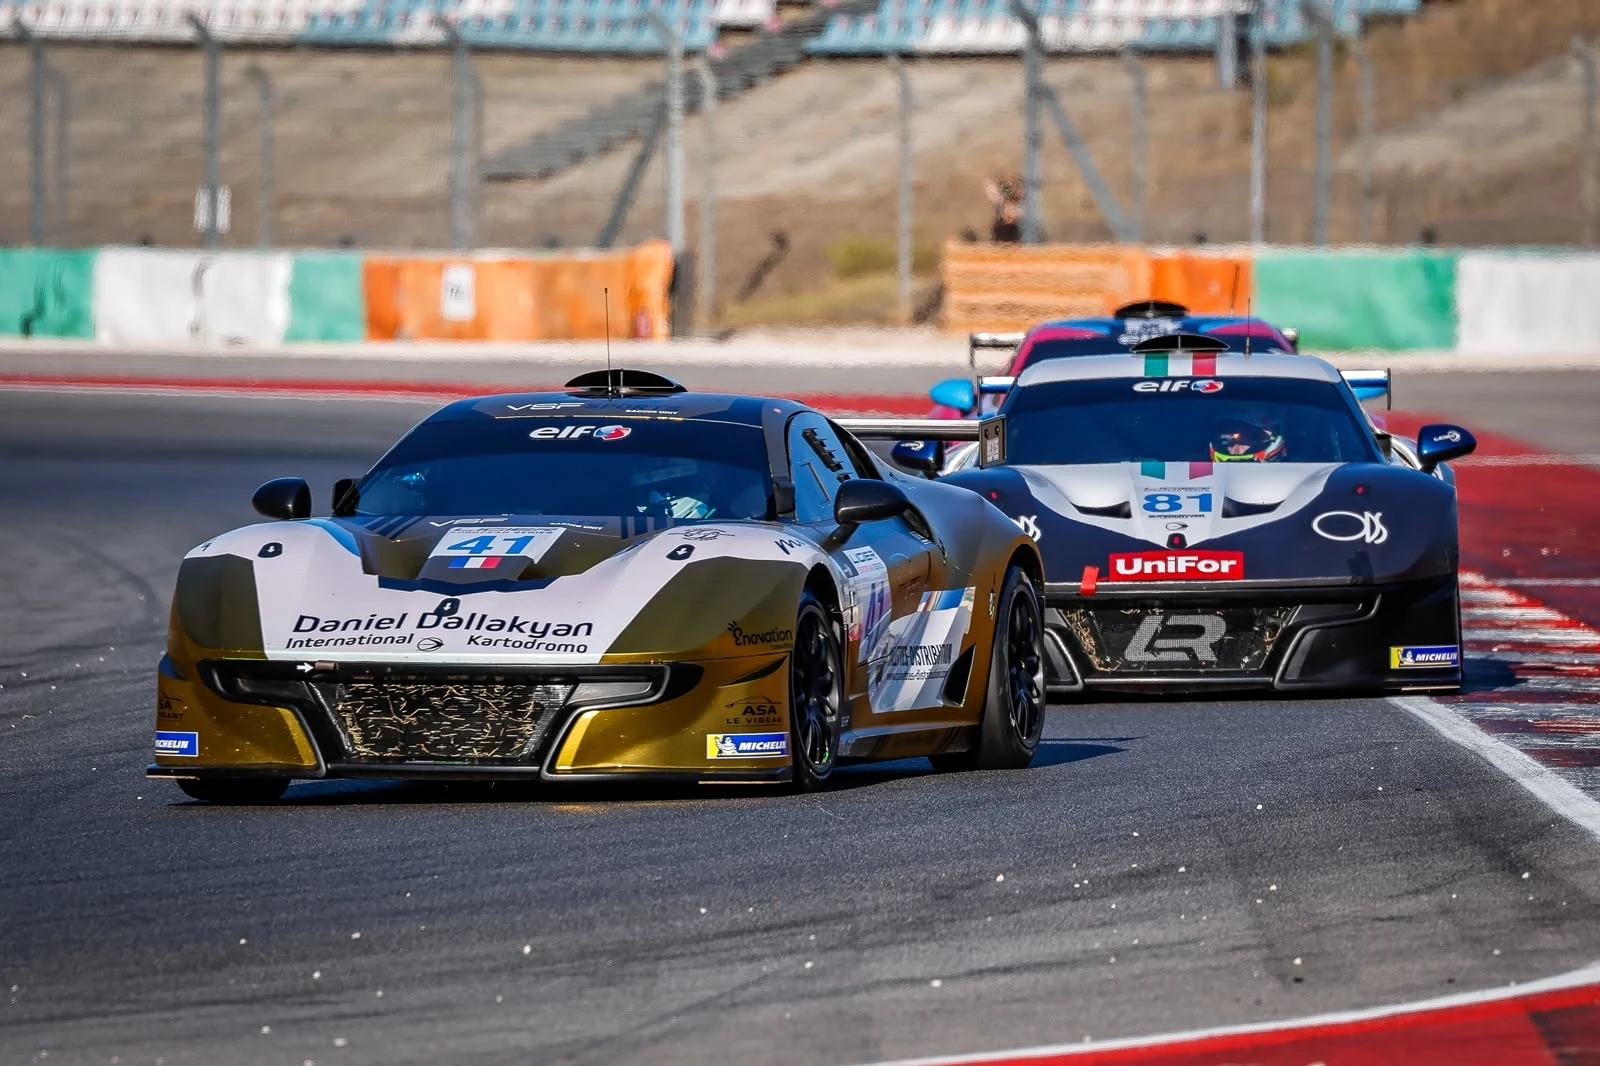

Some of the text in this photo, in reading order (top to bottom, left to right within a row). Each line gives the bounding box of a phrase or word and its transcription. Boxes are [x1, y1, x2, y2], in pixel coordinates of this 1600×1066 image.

[1132, 380, 1190, 392] elf
[507, 402, 585, 411] VSF
[529, 425, 596, 439] elf
[1142, 493, 1213, 513] 81
[429, 517, 509, 527] VSF
[447, 535, 535, 554] 41
[1115, 555, 1237, 575] UniFor
[292, 612, 594, 639] Daniel Dallakyan
[285, 633, 589, 654] International Kartodromo
[1415, 652, 1458, 662] MICHELIN
[742, 705, 777, 716] ASA
[726, 717, 742, 725] LE
